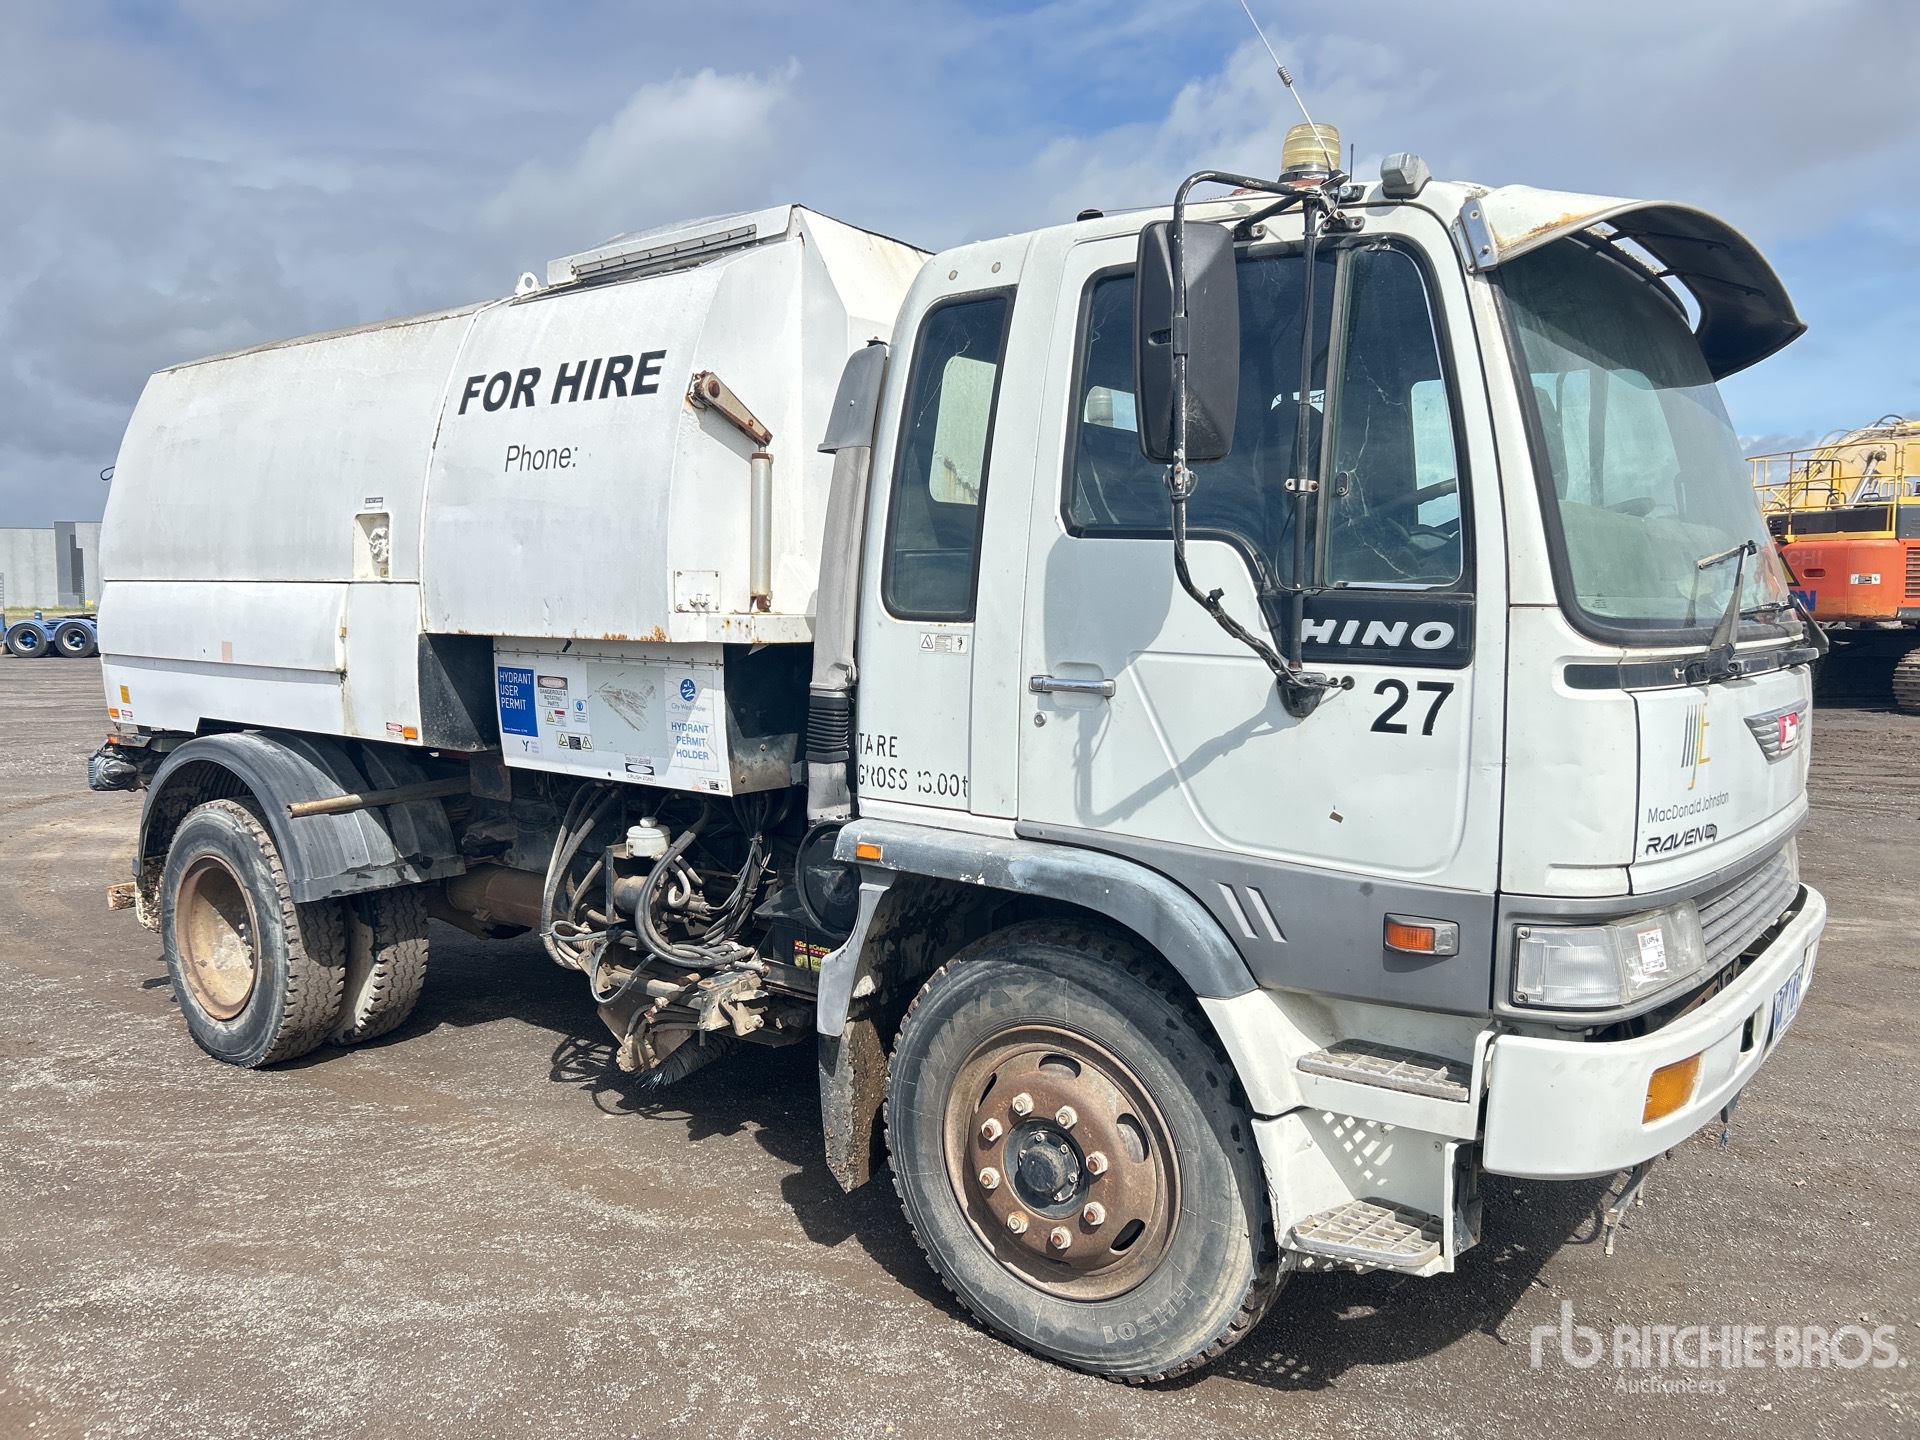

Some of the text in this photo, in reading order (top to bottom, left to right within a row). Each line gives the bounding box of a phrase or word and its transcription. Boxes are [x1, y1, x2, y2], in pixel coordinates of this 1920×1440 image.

[458, 349, 667, 415] FOR HIRE
[505, 445, 578, 472] Phone:
[1301, 618, 1455, 650] HINO
[500, 671, 531, 684] HYDRANT
[501, 684, 518, 696] USER
[539, 688, 562, 696] DANGEROUS
[501, 697, 526, 710] PERMIT
[544, 694, 562, 702] ROTATING
[671, 702, 680, 711] City
[1370, 678, 1454, 736] 27
[671, 722, 709, 734] HYDRANT
[676, 735, 706, 747] PERMIT
[858, 732, 898, 758] TARE
[676, 749, 709, 760] HOLDER
[1647, 797, 1702, 824] MacDonald
[1645, 825, 1705, 856] RAVEN
[1102, 1280, 1194, 1344] HH301
